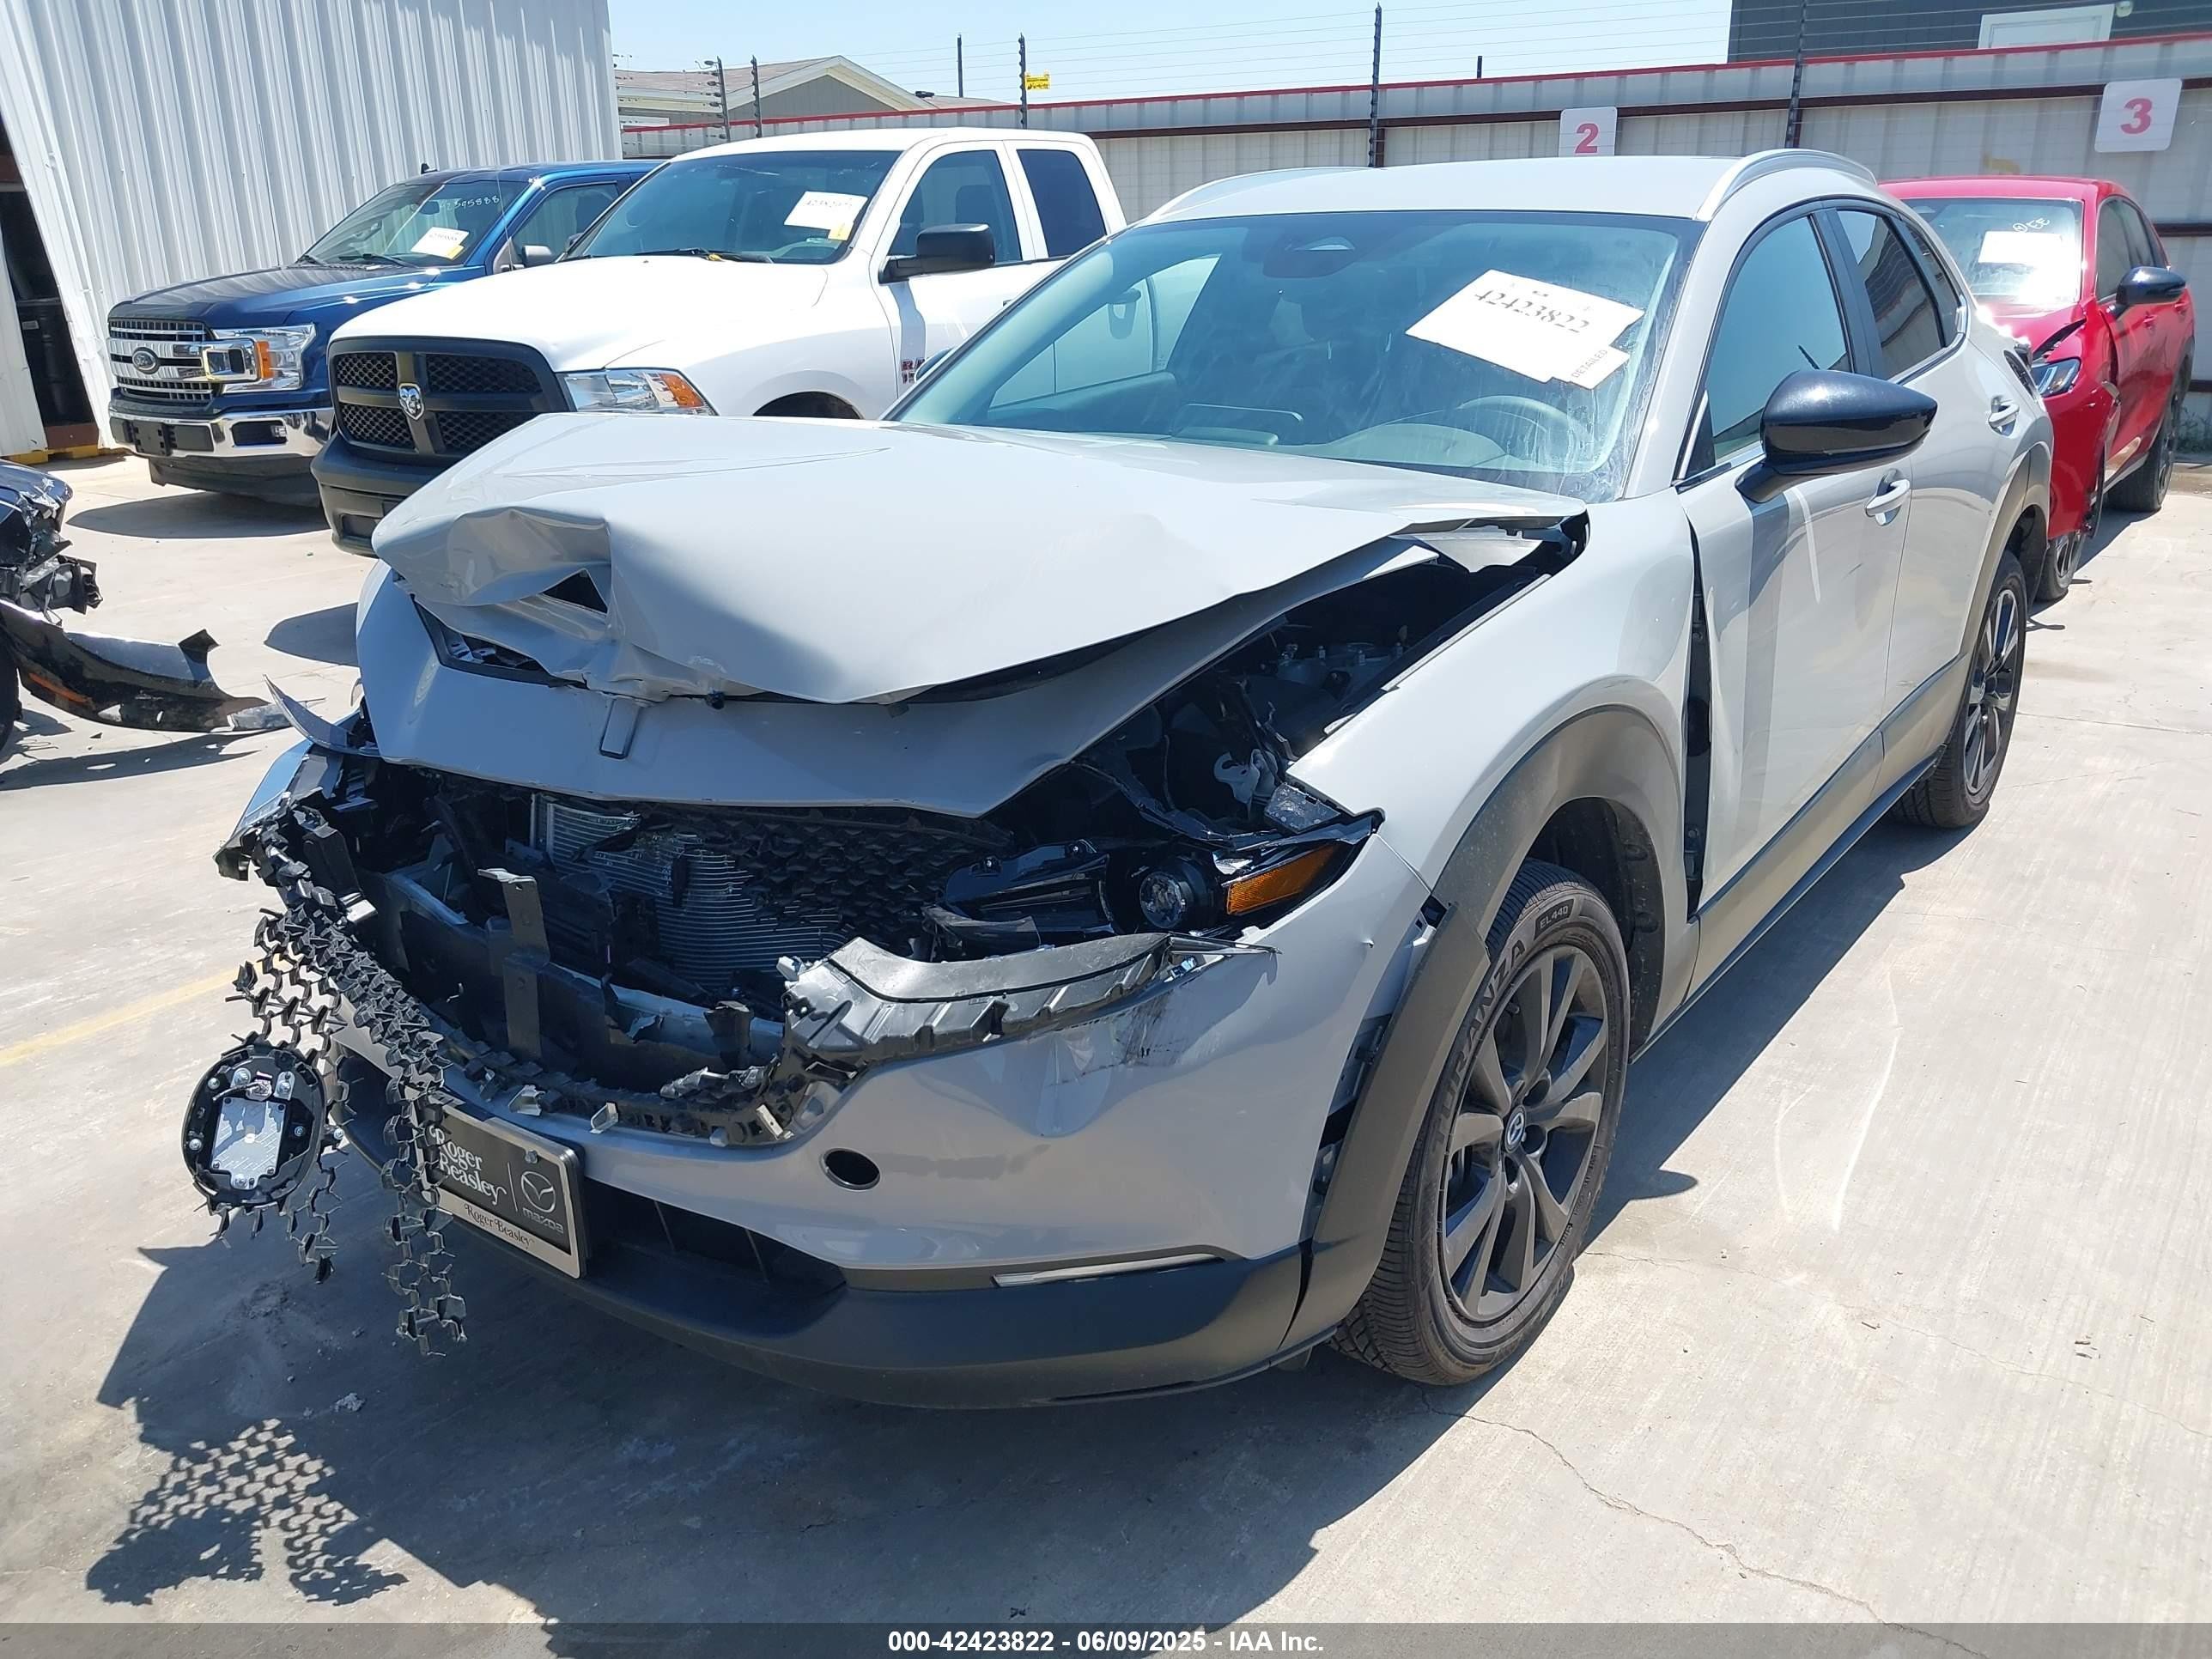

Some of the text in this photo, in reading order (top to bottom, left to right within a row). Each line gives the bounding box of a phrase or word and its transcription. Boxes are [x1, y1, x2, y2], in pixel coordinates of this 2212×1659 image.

[2120, 97, 2152, 134] 3
[1574, 123, 1599, 154] 2
[1474, 289, 1590, 333] 42423822
[901, 358, 926, 372] RA
[1571, 349, 1608, 380] DETAILED
[1431, 939, 1527, 1154] TURANZA
[429, 1124, 483, 1171] Roger
[439, 1152, 507, 1206] Beasley
[464, 1203, 535, 1249] Roger Beasley
